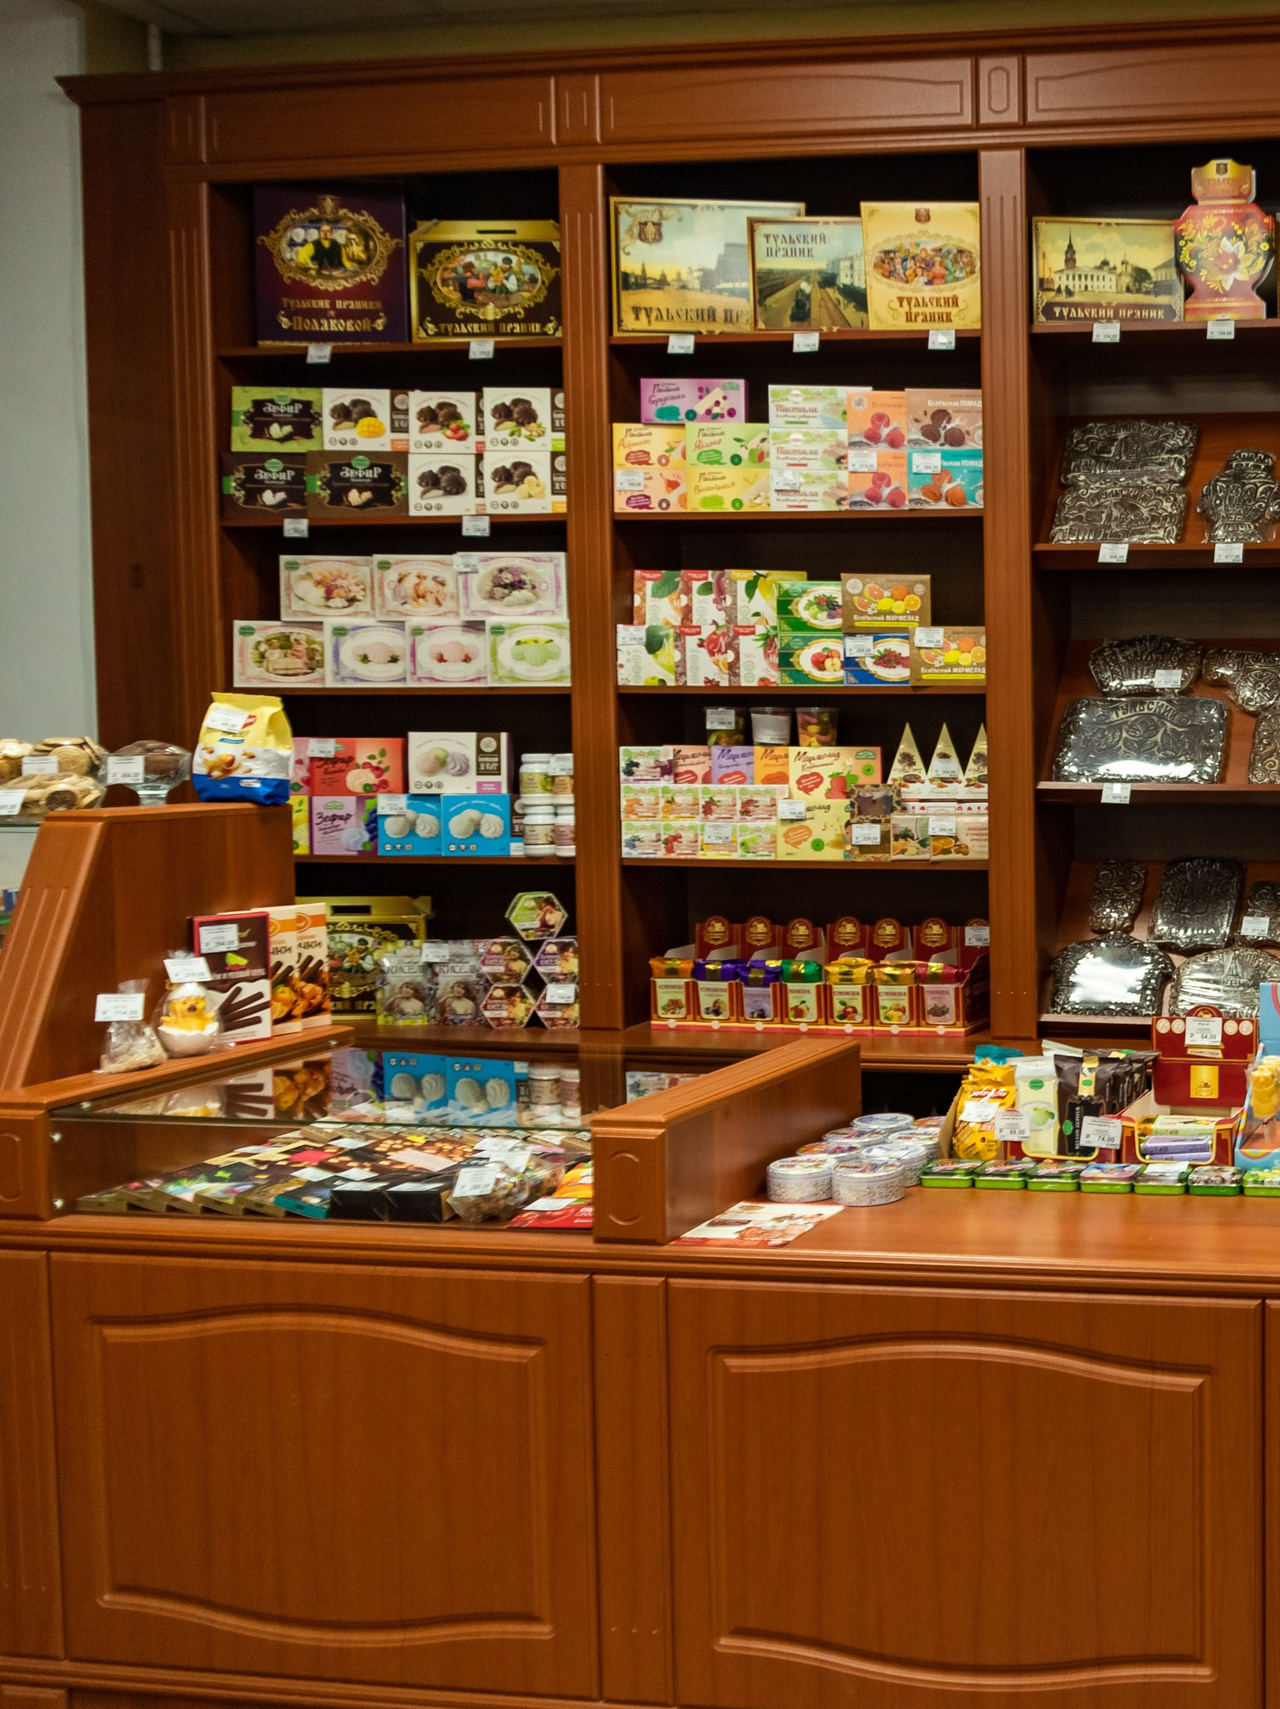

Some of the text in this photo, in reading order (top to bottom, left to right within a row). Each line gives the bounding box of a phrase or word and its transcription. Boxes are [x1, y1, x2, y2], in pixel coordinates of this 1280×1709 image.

[764, 232, 826, 249] ТУЛЬСКИЙ
[766, 247, 815, 258] ПРЯНИК
[897, 296, 960, 311] ТУЛЬСКИЙ
[631, 305, 717, 327] ТУЛЬСКИЙ
[905, 311, 953, 323] ПРЯНИК
[1053, 306, 1164, 321] ТУЛЬСКИЙ ПРЯНИК
